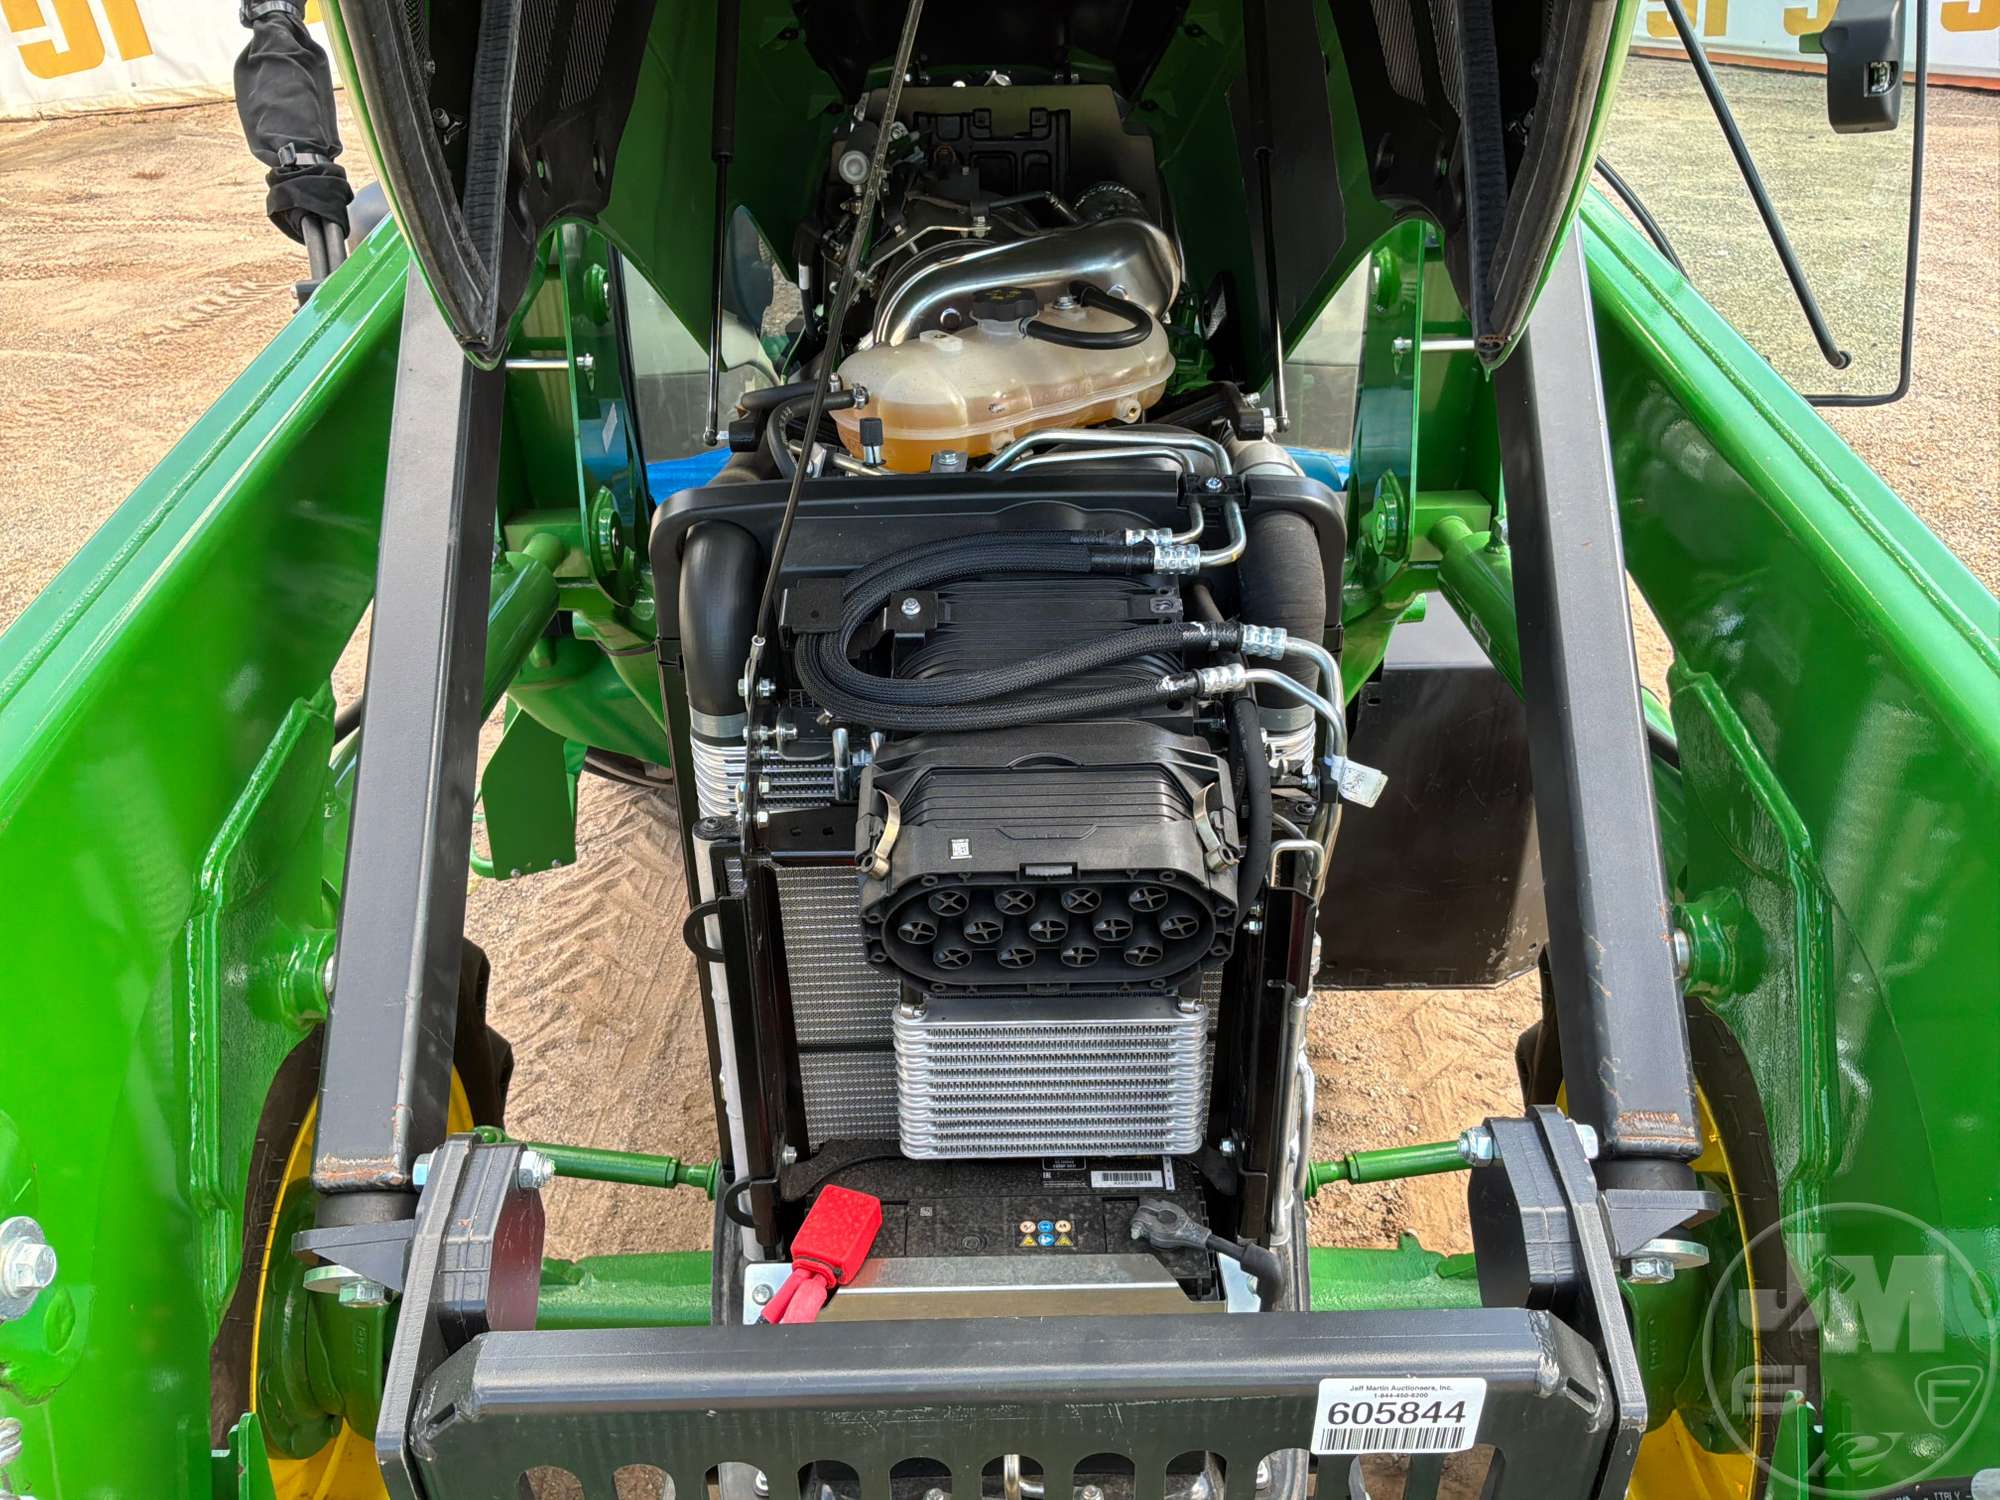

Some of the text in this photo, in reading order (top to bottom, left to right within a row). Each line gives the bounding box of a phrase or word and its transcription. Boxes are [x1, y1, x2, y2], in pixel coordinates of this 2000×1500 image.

[1349, 1384, 1453, 1392] Jeff Martin Auctioneers, Inc.
[1327, 1400, 1467, 1425] 605844
